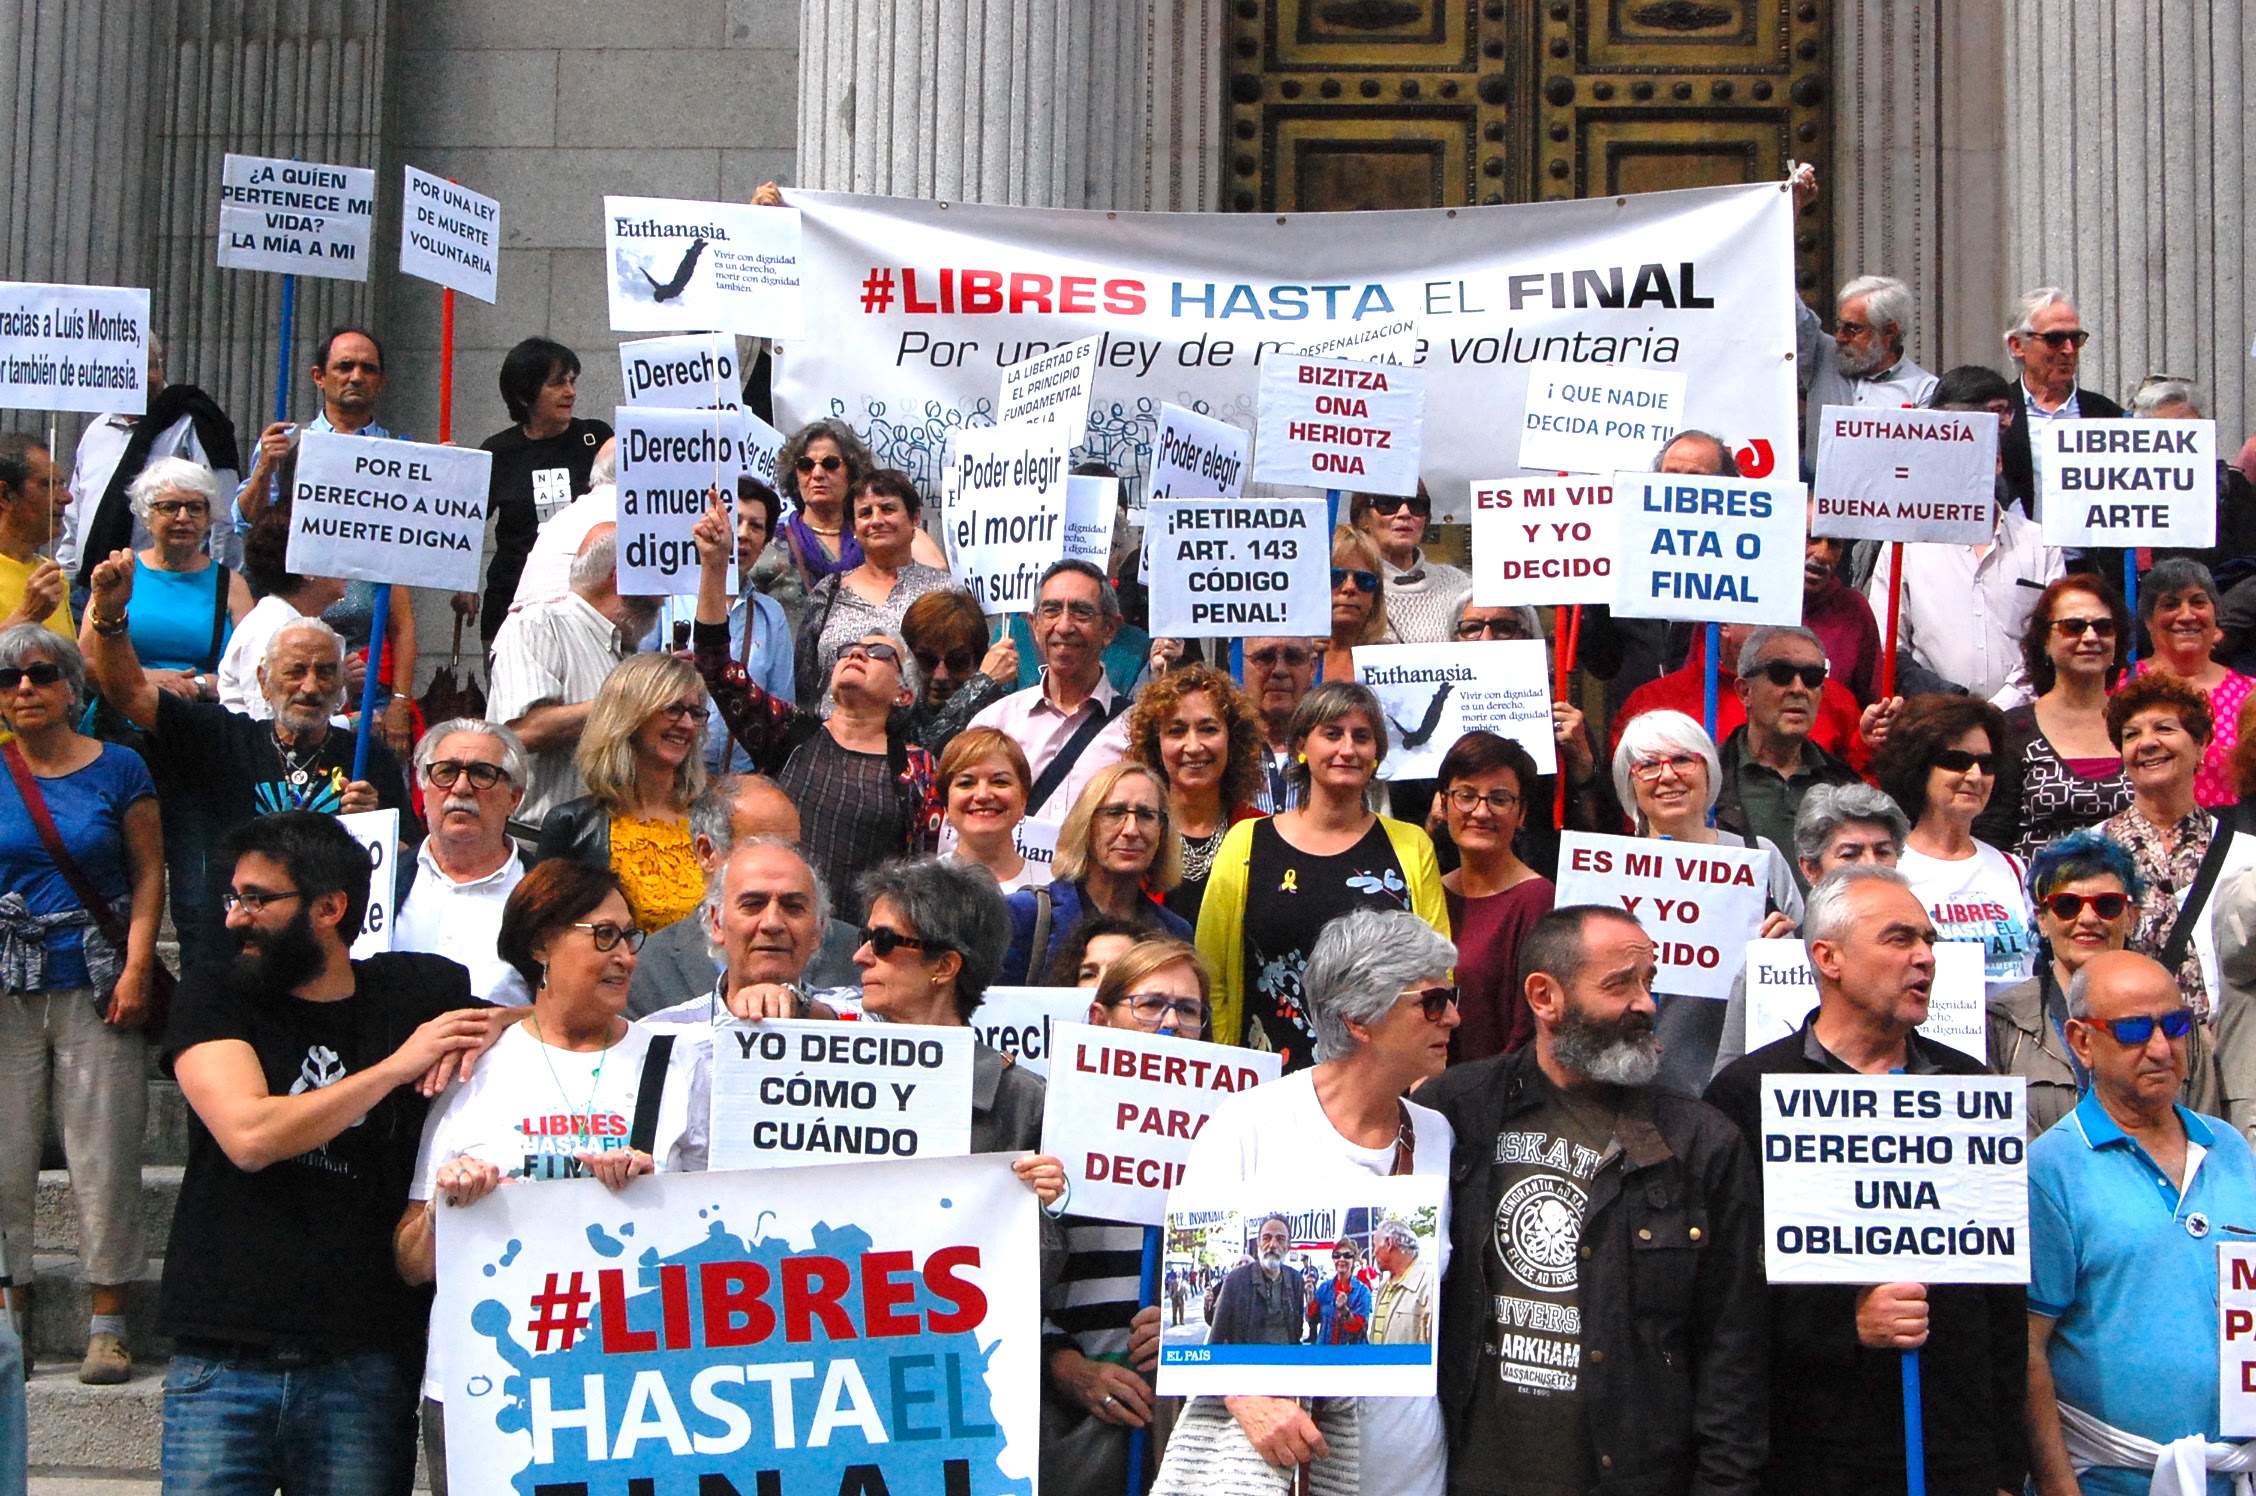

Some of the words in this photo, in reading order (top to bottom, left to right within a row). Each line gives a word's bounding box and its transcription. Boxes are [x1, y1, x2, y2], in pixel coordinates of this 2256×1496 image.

[249, 166, 275, 185] ¿A
[282, 167, 347, 189] QUÍEN
[222, 185, 340, 212] PERTENECE
[348, 198, 372, 216] MI
[413, 177, 441, 201] POR
[443, 190, 471, 212] UNA
[474, 202, 496, 223] LEY
[266, 213, 325, 233] VIDA?
[417, 206, 435, 226] DE
[438, 215, 489, 247] MUERTE
[616, 219, 731, 241] Euthanasia.
[231, 232, 255, 249] LA
[263, 231, 303, 255] MÍA
[308, 241, 323, 256] A
[330, 243, 355, 260] MI
[410, 230, 492, 275] VOLUNTARIA
[713, 249, 736, 261] Vivir
[737, 253, 754, 262] con
[756, 253, 796, 268] dignidad
[714, 261, 724, 269] es
[726, 262, 739, 271] un
[739, 263, 777, 275] derecho,
[715, 271, 741, 281] morir
[743, 274, 759, 283] con
[761, 274, 800, 287] dignidad
[860, 267, 1147, 316] #LIBRES
[1171, 281, 1395, 322] HASTA
[1425, 280, 1485, 315] EL
[1509, 262, 1715, 310] FINAL
[43, 314, 51, 338] a
[55, 307, 84, 339] Luís
[88, 308, 140, 349] Montes,
[896, 331, 978, 367] Por
[996, 342, 1073, 367] un
[1098, 330, 1161, 377] ley
[1178, 332, 1234, 366] de
[1450, 326, 1680, 363] voluntaria
[1008, 369, 1020, 384] LA
[1024, 350, 1073, 378] LIBERTAD
[1076, 344, 1090, 359] ES
[9, 353, 57, 386] también
[60, 355, 75, 387] de
[78, 358, 139, 390] eutanasia.
[628, 351, 732, 399] ¡Derecho
[1012, 387, 1024, 400] EL
[1028, 366, 1080, 395] PRINCIPIO
[1299, 365, 1389, 391] BIZITZA
[1004, 384, 1082, 421] FUNDAMENTAL
[1315, 396, 1368, 418] ONA
[1561, 384, 1602, 404] QUE
[1607, 388, 1668, 410] NADIE
[1289, 422, 1391, 449] HERIOTZ
[1526, 413, 1599, 435] DECIDA
[1605, 422, 1645, 440] POR
[1835, 419, 1975, 443] EUTHANASÍA
[622, 429, 732, 471] ¡Derecho
[2058, 429, 2198, 455] LIBREAK
[355, 456, 401, 478] POR
[408, 462, 432, 482] EL
[957, 452, 1010, 500] ¡Poder
[1013, 447, 1061, 494] elegir
[1157, 426, 1202, 471] ¡Poder
[1202, 444, 1241, 492] elegir
[1312, 453, 1365, 475] ONA
[2061, 467, 2195, 492] BUKATU
[297, 483, 408, 512] DERECHO
[413, 497, 429, 514] A
[435, 500, 482, 520] UNA
[625, 488, 638, 515] a
[647, 482, 733, 514] muere
[1477, 489, 1513, 510] ES
[1523, 487, 1555, 508] MI
[1565, 486, 1613, 506] VID
[1643, 485, 1773, 519] LIBRES
[1818, 498, 1890, 518] BUENA
[1896, 501, 1986, 522] MUERTE
[957, 510, 976, 548] el
[985, 505, 1058, 545] morir
[1168, 508, 1306, 535] ¡RETIRADA
[2084, 504, 2170, 529] ARTE
[301, 516, 392, 542] MUERTE
[399, 527, 472, 551] DIGNA
[1522, 524, 1541, 543] Y
[1551, 522, 1592, 543] YO
[1650, 528, 1723, 558] ATA
[1736, 533, 1761, 561] O
[1177, 540, 1236, 561] ART.
[1247, 540, 1298, 560] 143
[1188, 566, 1289, 592] CÓDIGO
[1504, 557, 1611, 580] DECIDO
[1651, 570, 1759, 603] FINAL
[1192, 602, 1287, 624] PENAL!
[1363, 663, 1477, 685] Euthanasia.
[1460, 690, 1482, 700] Vivir
[1484, 692, 1501, 700] con
[1503, 689, 1544, 702] dignidad
[1461, 703, 1470, 711] es
[1472, 702, 1484, 711] un
[1462, 712, 1488, 722] morir
[1490, 712, 1507, 721] con
[1509, 710, 1549, 724] dignidad
[1571, 848, 1613, 874] ES
[1624, 853, 1663, 878] MI
[1675, 858, 1755, 887] VIDA
[1620, 894, 1643, 914] Y
[1653, 898, 1700, 924] YO
[1935, 903, 2009, 924] LIBRES
[734, 1031, 786, 1061] YO
[801, 1034, 944, 1069] DECIDO
[1076, 1043, 1259, 1094] LIBERTAD
[760, 1071, 877, 1110] CÓMO
[890, 1083, 916, 1111] Y
[1774, 1089, 1878, 1119] VIVIR
[1893, 1090, 1942, 1119] ES
[1957, 1090, 2013, 1120] UN
[522, 1114, 628, 1136] LIBRES
[753, 1117, 918, 1157] CUÁNDO
[1766, 1134, 1953, 1166] DERECHO
[1967, 1135, 2024, 1166] NO
[1854, 1180, 1941, 1210] UNA
[1776, 1219, 2015, 1256] OBLIGACIÓN
[527, 1245, 989, 1356] #LIBRES
[1167, 1352, 1183, 1361] EL
[1184, 1349, 1211, 1361] PAÍS
[1501, 1333, 1580, 1368] ARKHAM
[529, 1357, 891, 1466] HASTA
[888, 1352, 997, 1442] EL
